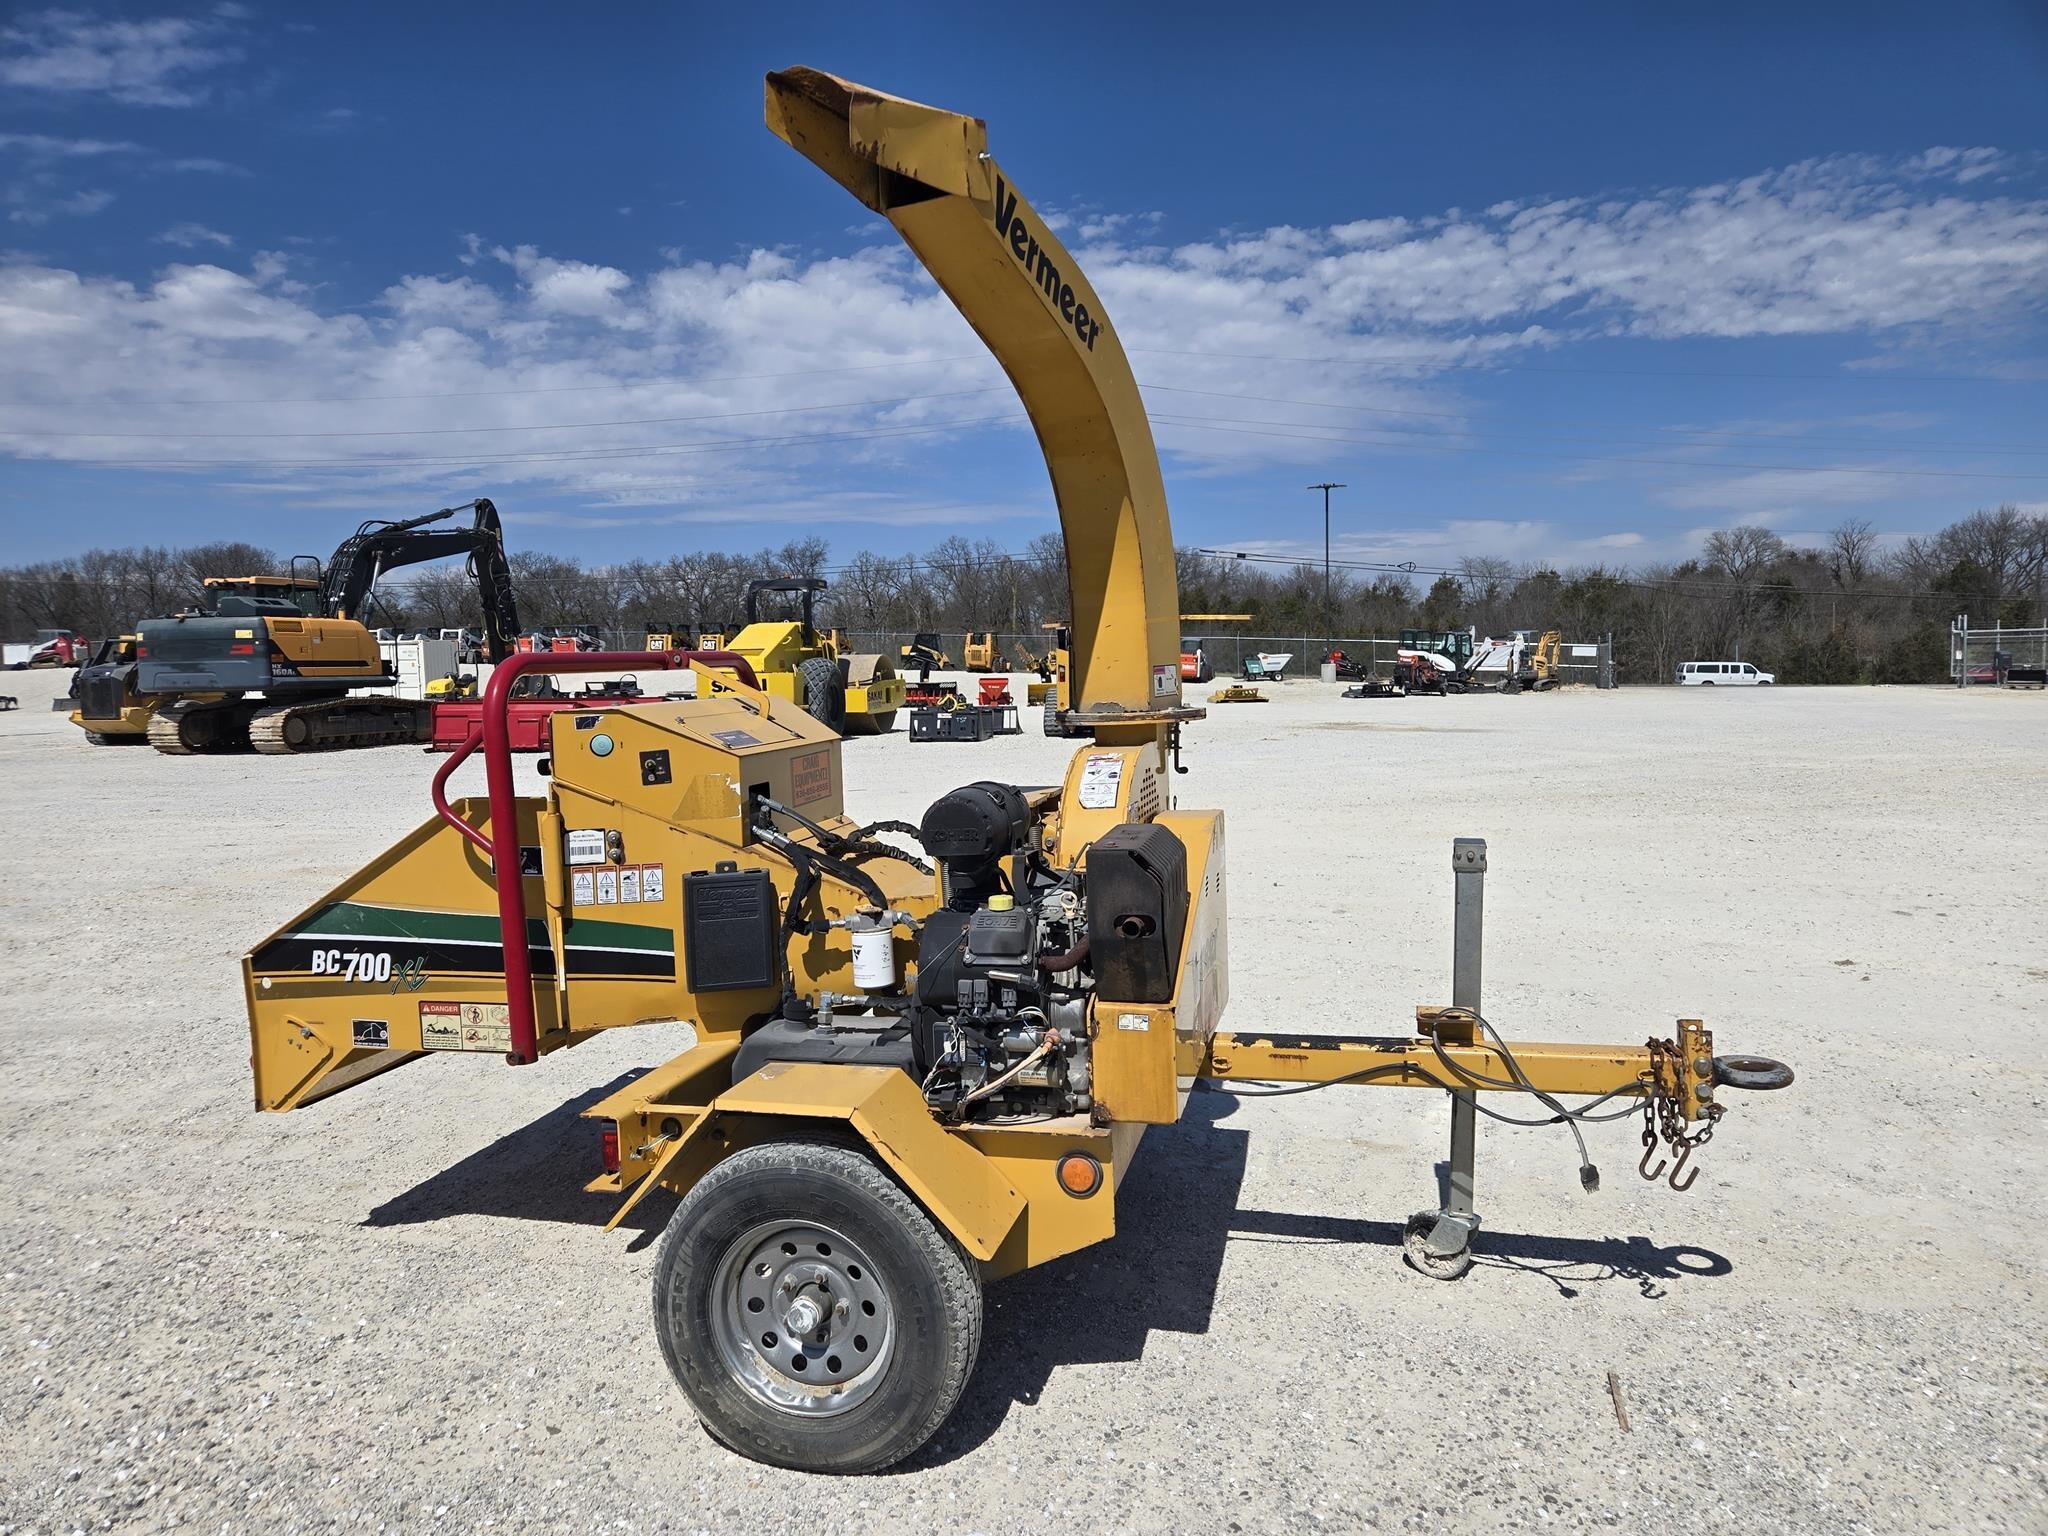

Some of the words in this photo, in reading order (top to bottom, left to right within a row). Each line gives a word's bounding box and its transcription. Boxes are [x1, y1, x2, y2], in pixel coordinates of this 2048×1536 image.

[994, 174, 1099, 353] Vermeer
[650, 640, 664, 650] CAT
[703, 640, 716, 650] CAT
[934, 828, 981, 842] KOHLER
[430, 1005, 458, 1013] DANGER
